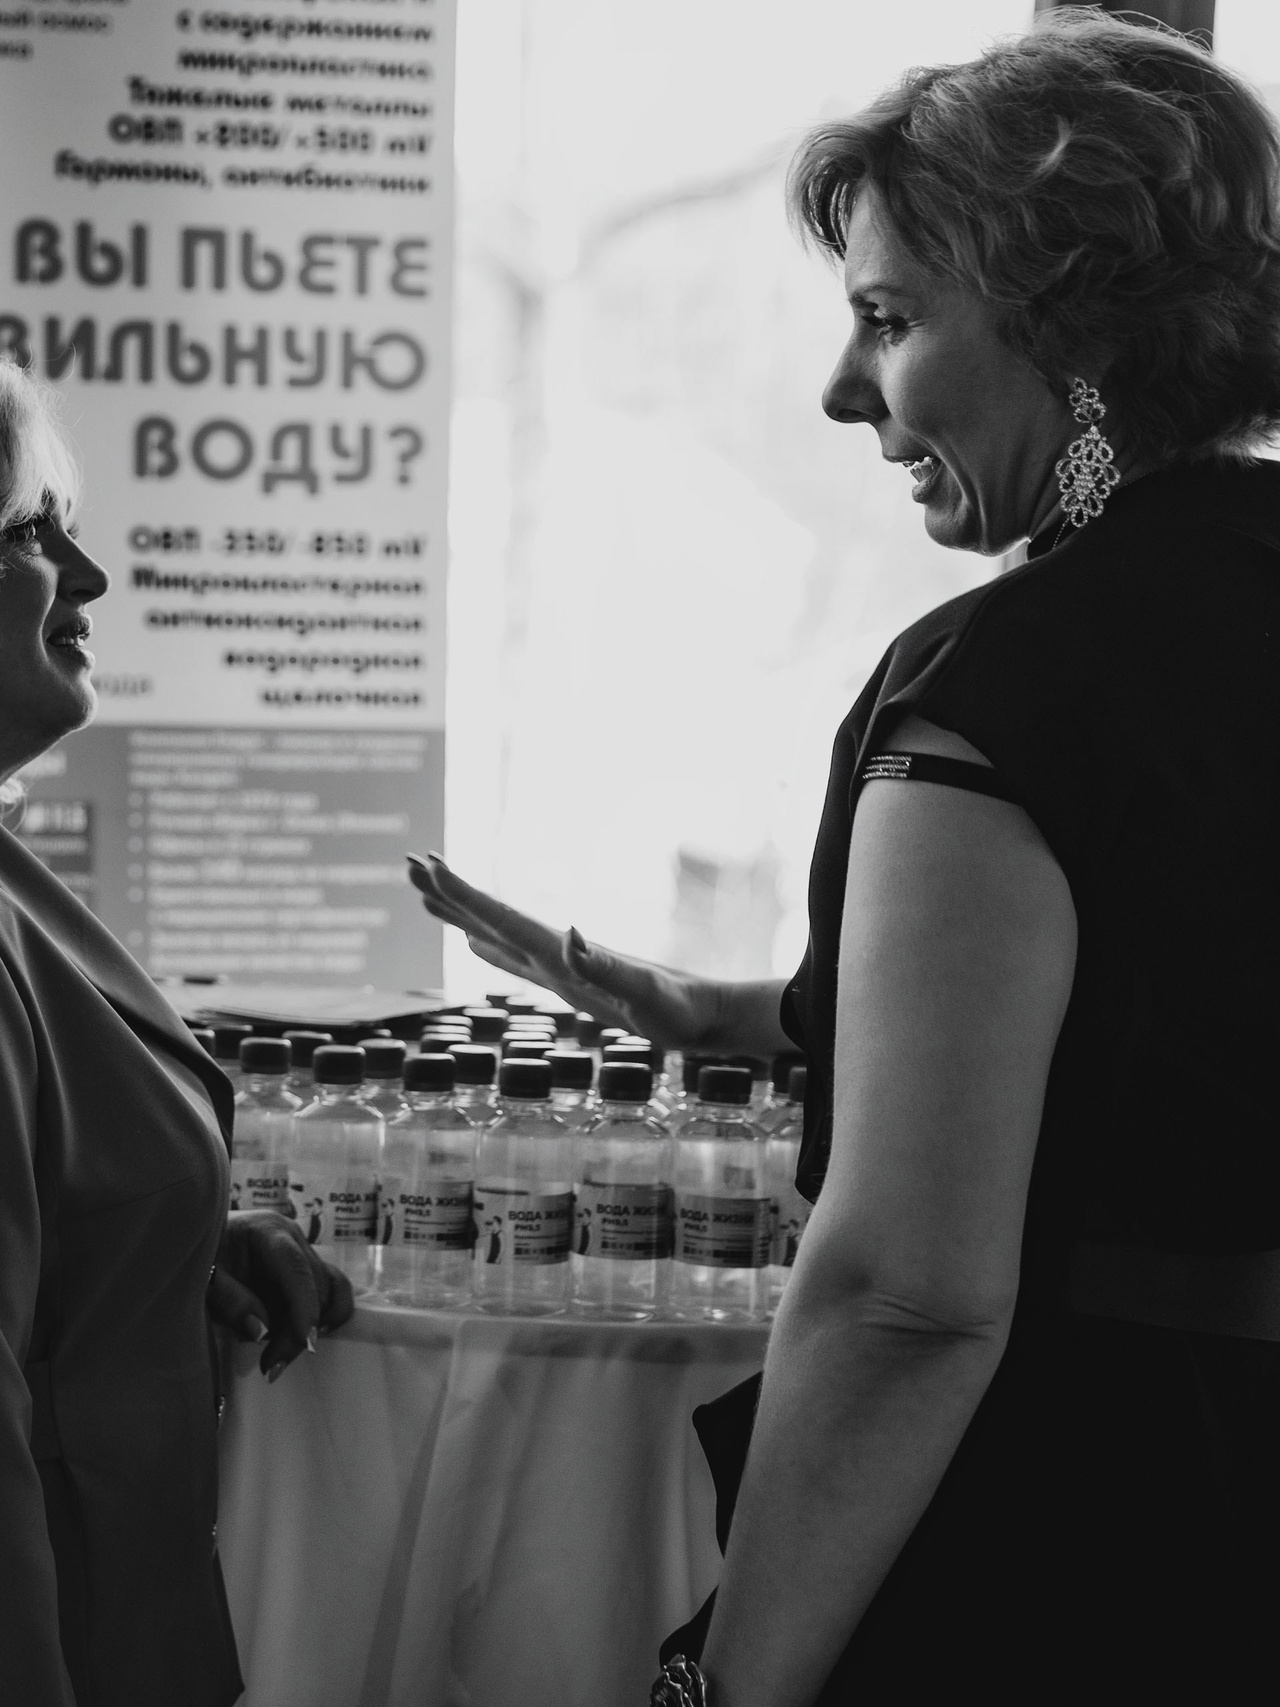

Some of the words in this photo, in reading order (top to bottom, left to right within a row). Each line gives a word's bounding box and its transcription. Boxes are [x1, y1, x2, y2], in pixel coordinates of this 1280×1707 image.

[14, 218, 149, 288] ВЫ
[180, 224, 431, 298] ПЬЕТЕ
[132, 414, 424, 496] ВОДУ?
[400, 1194, 433, 1207] ВОДА
[508, 1210, 542, 1221] ВОДА
[597, 1203, 630, 1215] ВОДА
[680, 1208, 709, 1222] ВОДА
